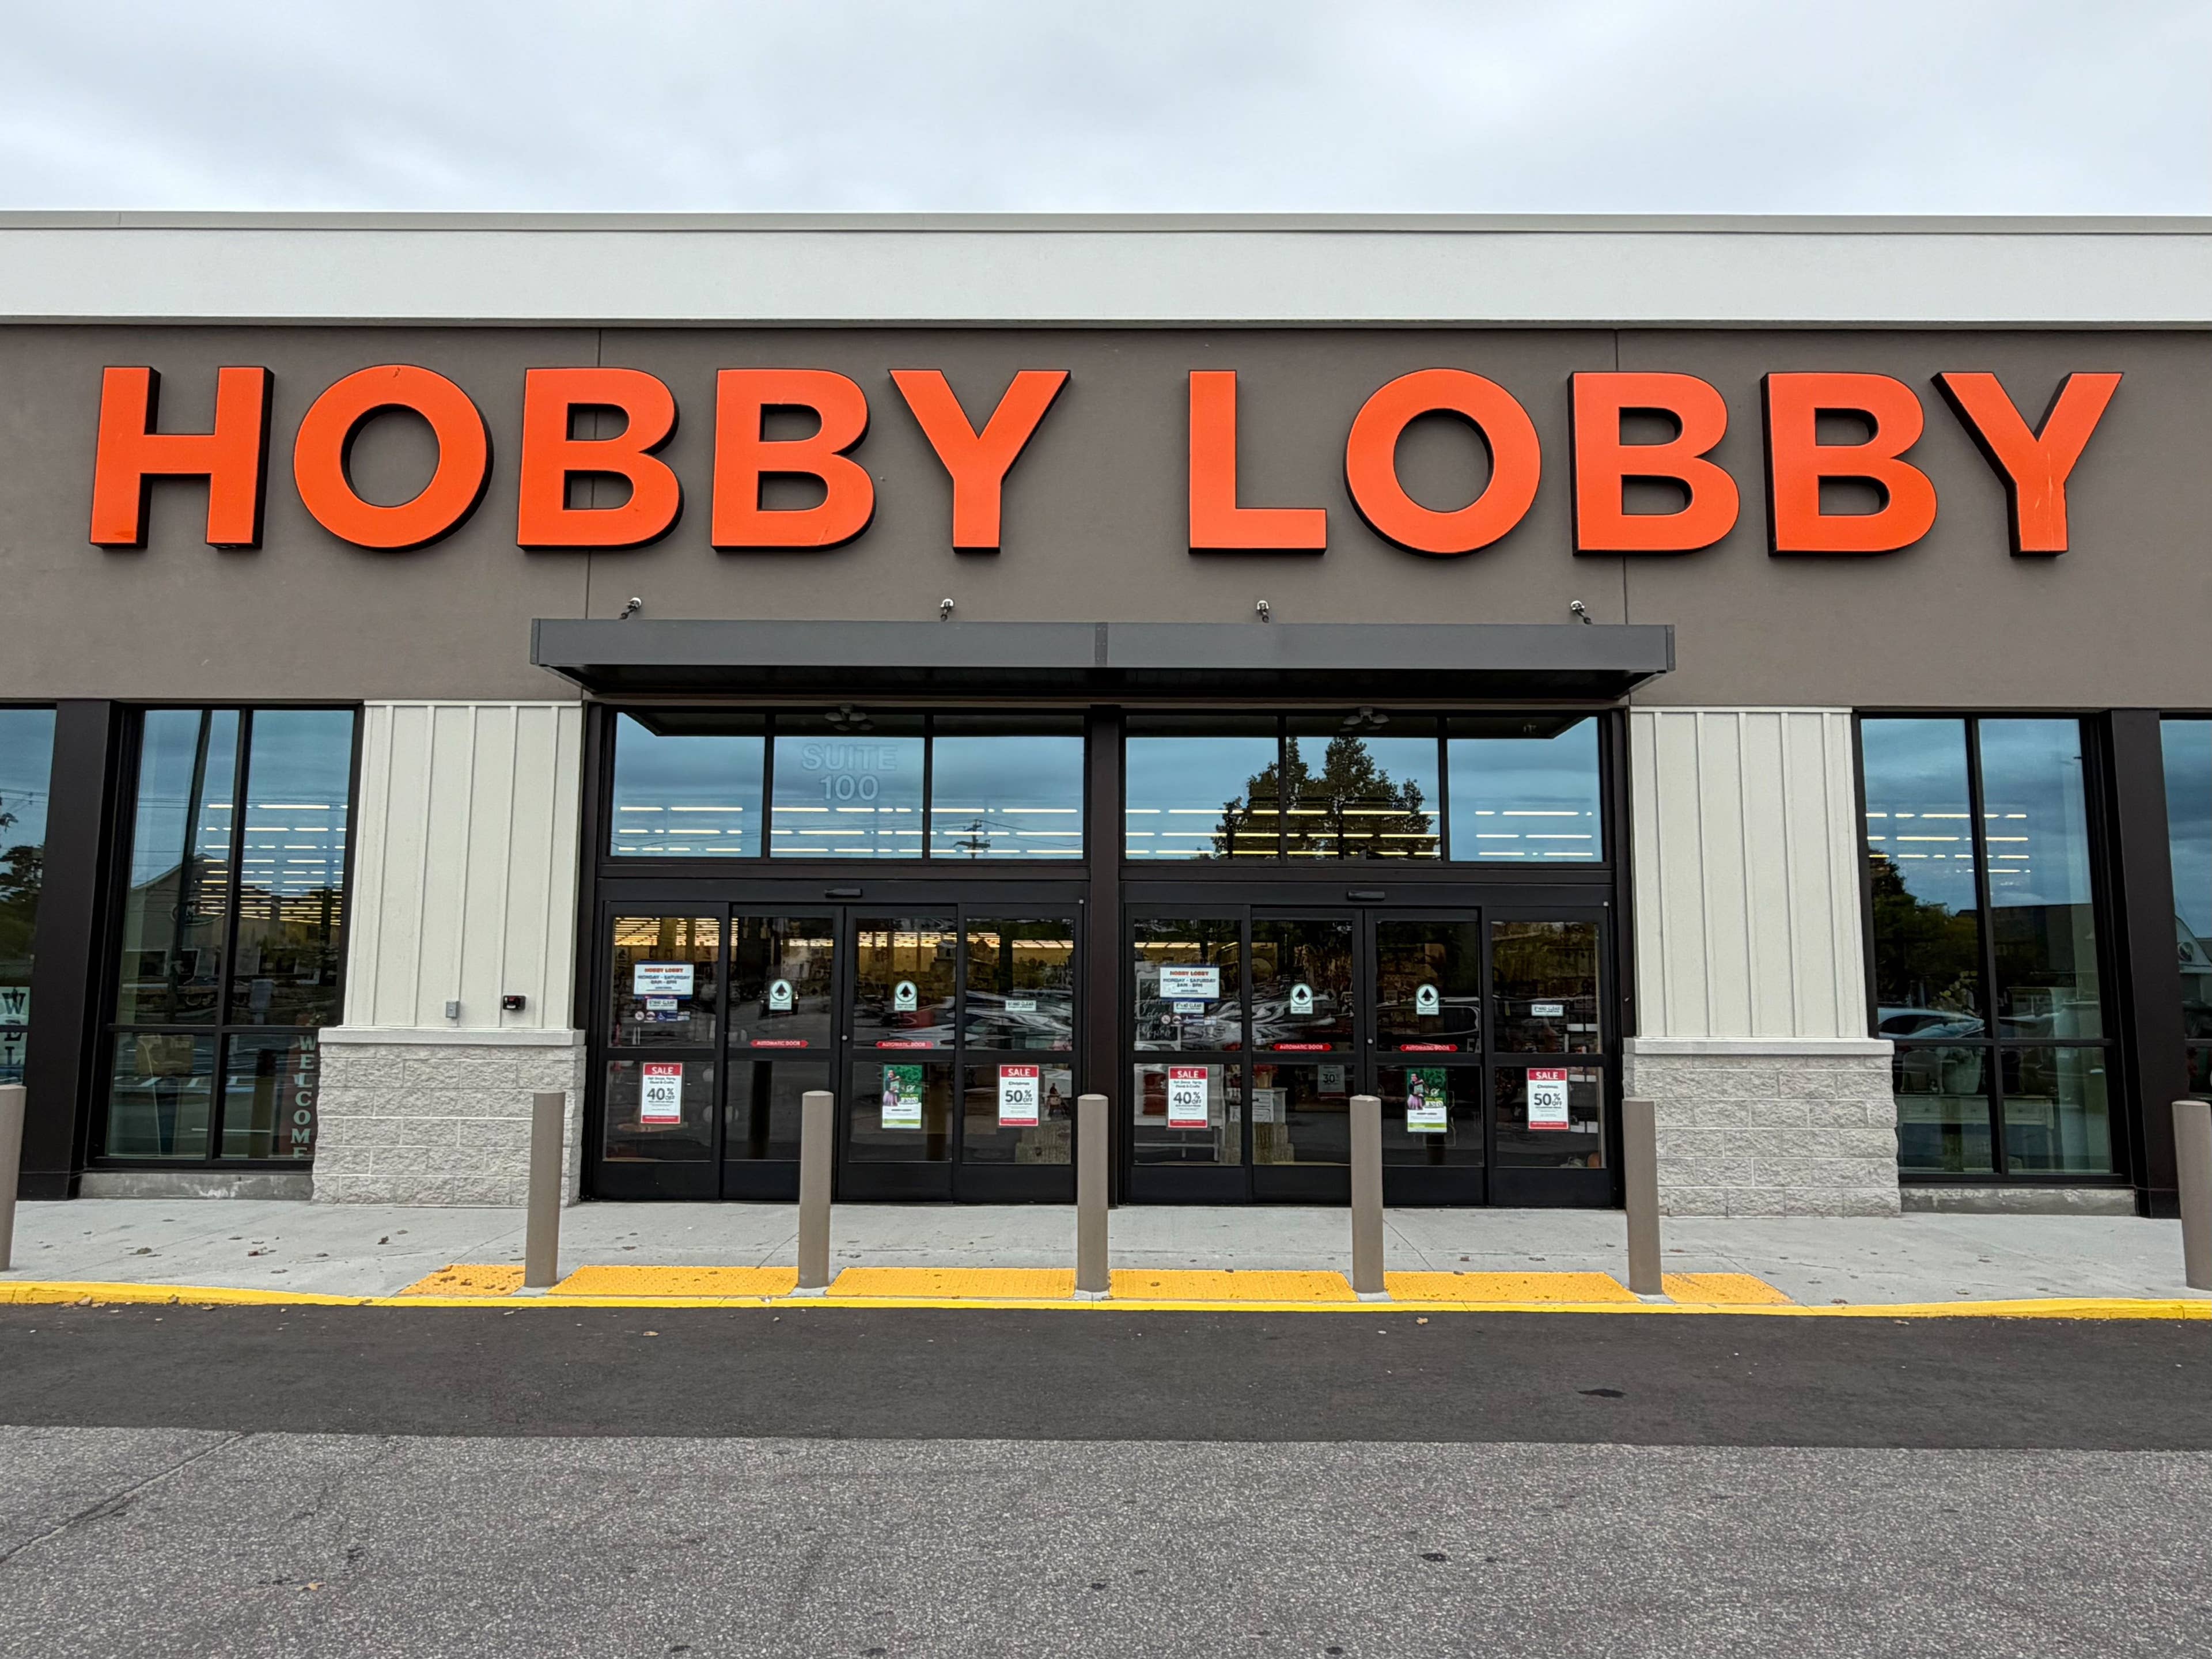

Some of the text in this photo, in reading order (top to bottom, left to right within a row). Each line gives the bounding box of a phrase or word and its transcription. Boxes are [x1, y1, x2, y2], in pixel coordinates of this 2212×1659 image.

[89, 364, 2124, 557] HOBBY LOBBY
[801, 744, 898, 771] SUITE
[820, 775, 879, 801] 100
[652, 1066, 674, 1075] SALE
[1008, 1068, 1031, 1077] SALE
[1177, 1070, 1199, 1078] SALE
[1536, 1071, 1558, 1080] SALE
[1323, 1074, 1335, 1083] 30
[290, 1036, 316, 1159] WELCOME
[647, 1088, 665, 1100] 40
[1005, 1090, 1022, 1103] 50
[1173, 1092, 1191, 1104] 40
[1534, 1093, 1551, 1105] 50
